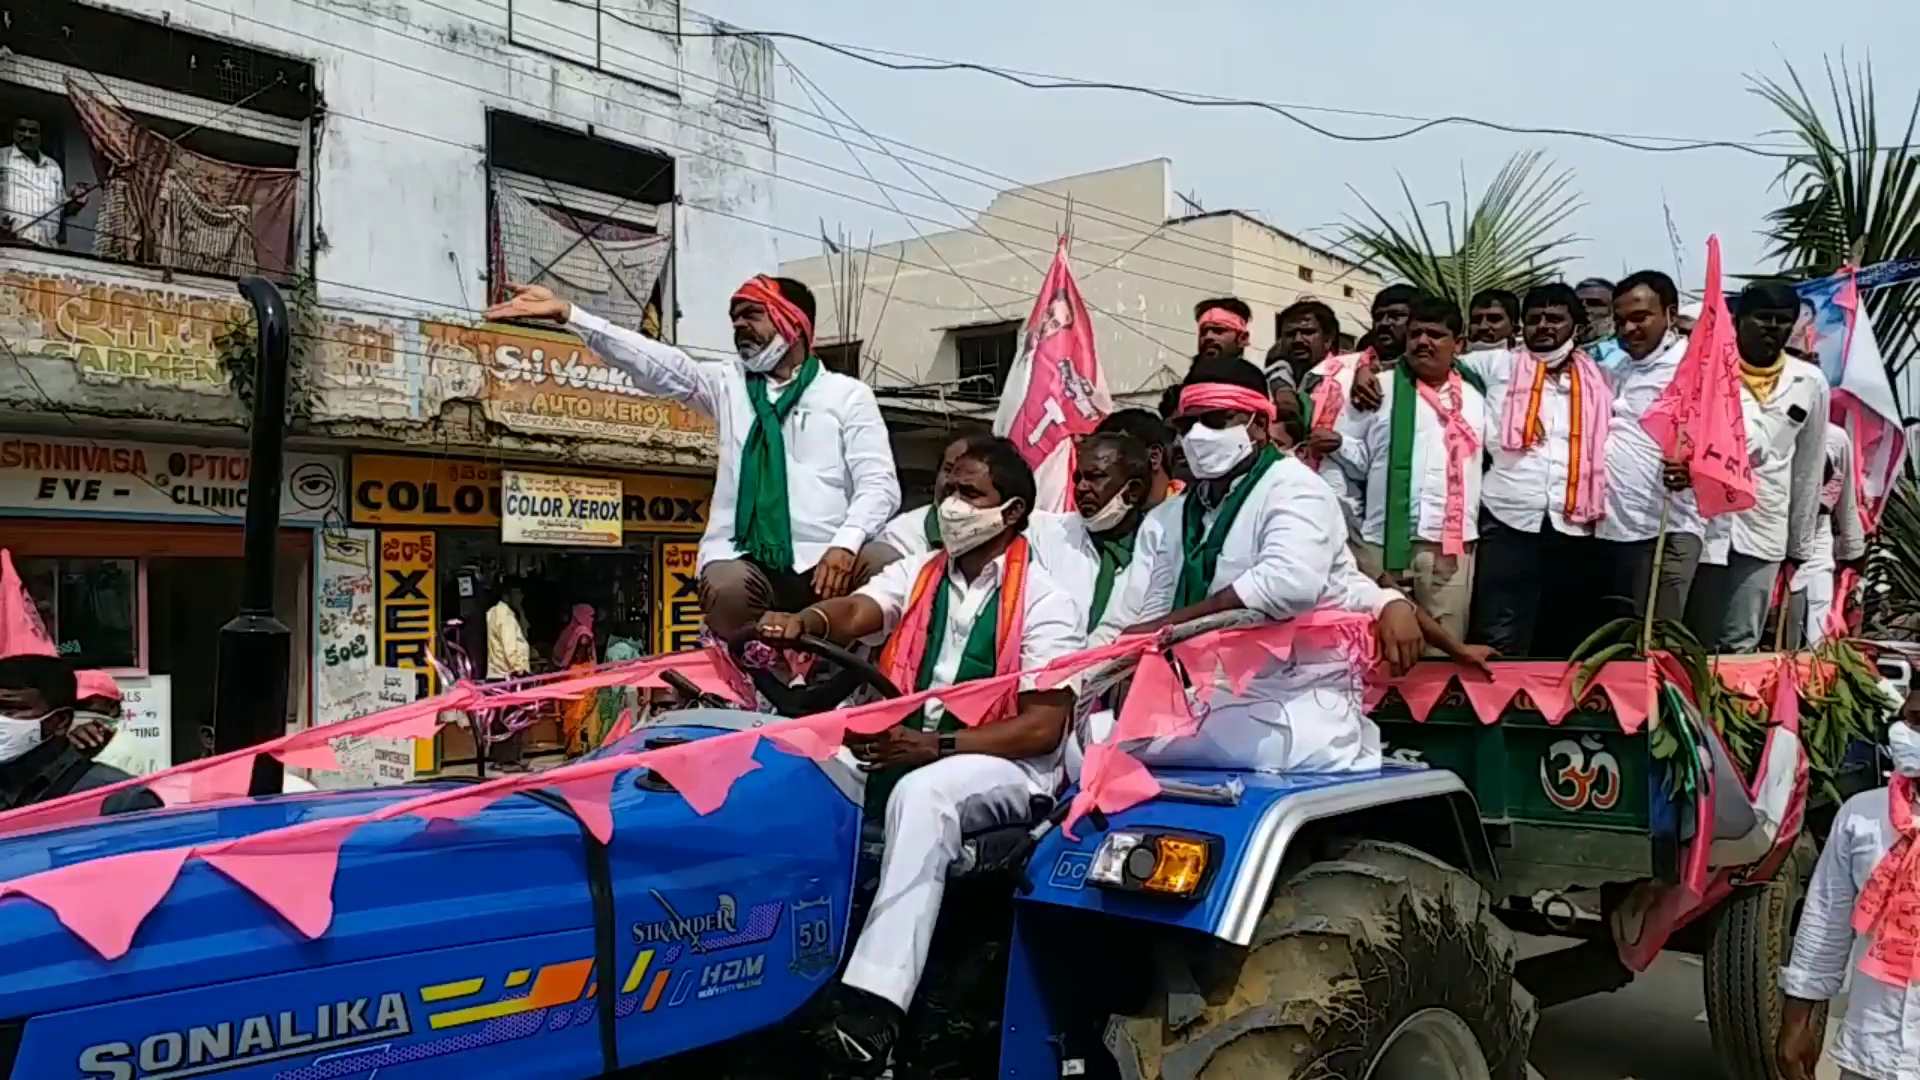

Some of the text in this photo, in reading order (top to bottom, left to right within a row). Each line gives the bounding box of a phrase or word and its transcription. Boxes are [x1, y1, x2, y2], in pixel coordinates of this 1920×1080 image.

[532, 392, 593, 418] AUTO
[604, 400, 671, 427] XEROX
[0, 440, 148, 474] SRINIVASA
[36, 477, 102, 501] EYE
[171, 484, 248, 508] CLINIC
[506, 494, 621, 521] COLOR XEROX
[1057, 860, 1086, 879] DC
[632, 906, 738, 945] SIKANDER
[799, 919, 828, 948] 50
[700, 953, 766, 987] HDM
[79, 991, 410, 1080] SONALIKA
